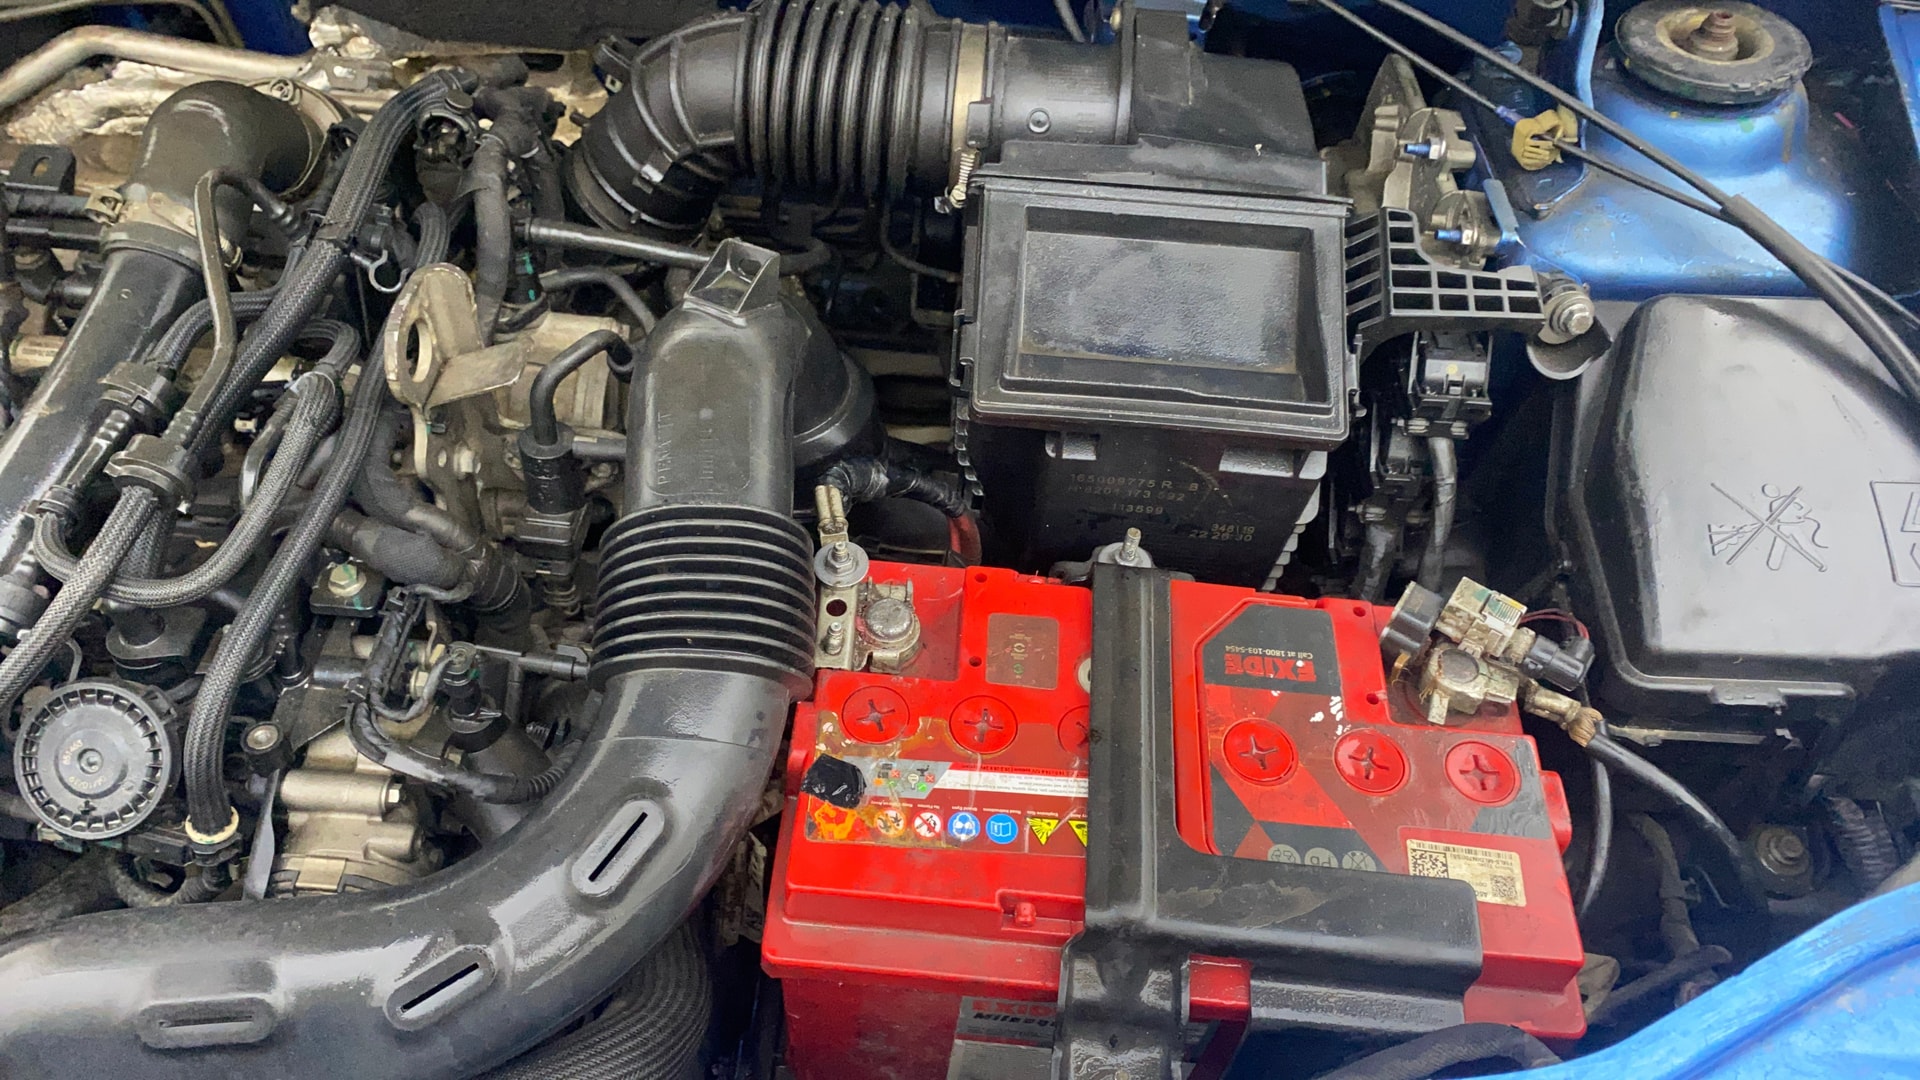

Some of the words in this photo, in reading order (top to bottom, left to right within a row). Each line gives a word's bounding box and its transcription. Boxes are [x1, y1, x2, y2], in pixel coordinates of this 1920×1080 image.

[1225, 645, 1286, 658] 1800-103-5454
[1287, 650, 1297, 658] at
[1297, 651, 1314, 660] Call
[1224, 653, 1317, 682] EXIDE
